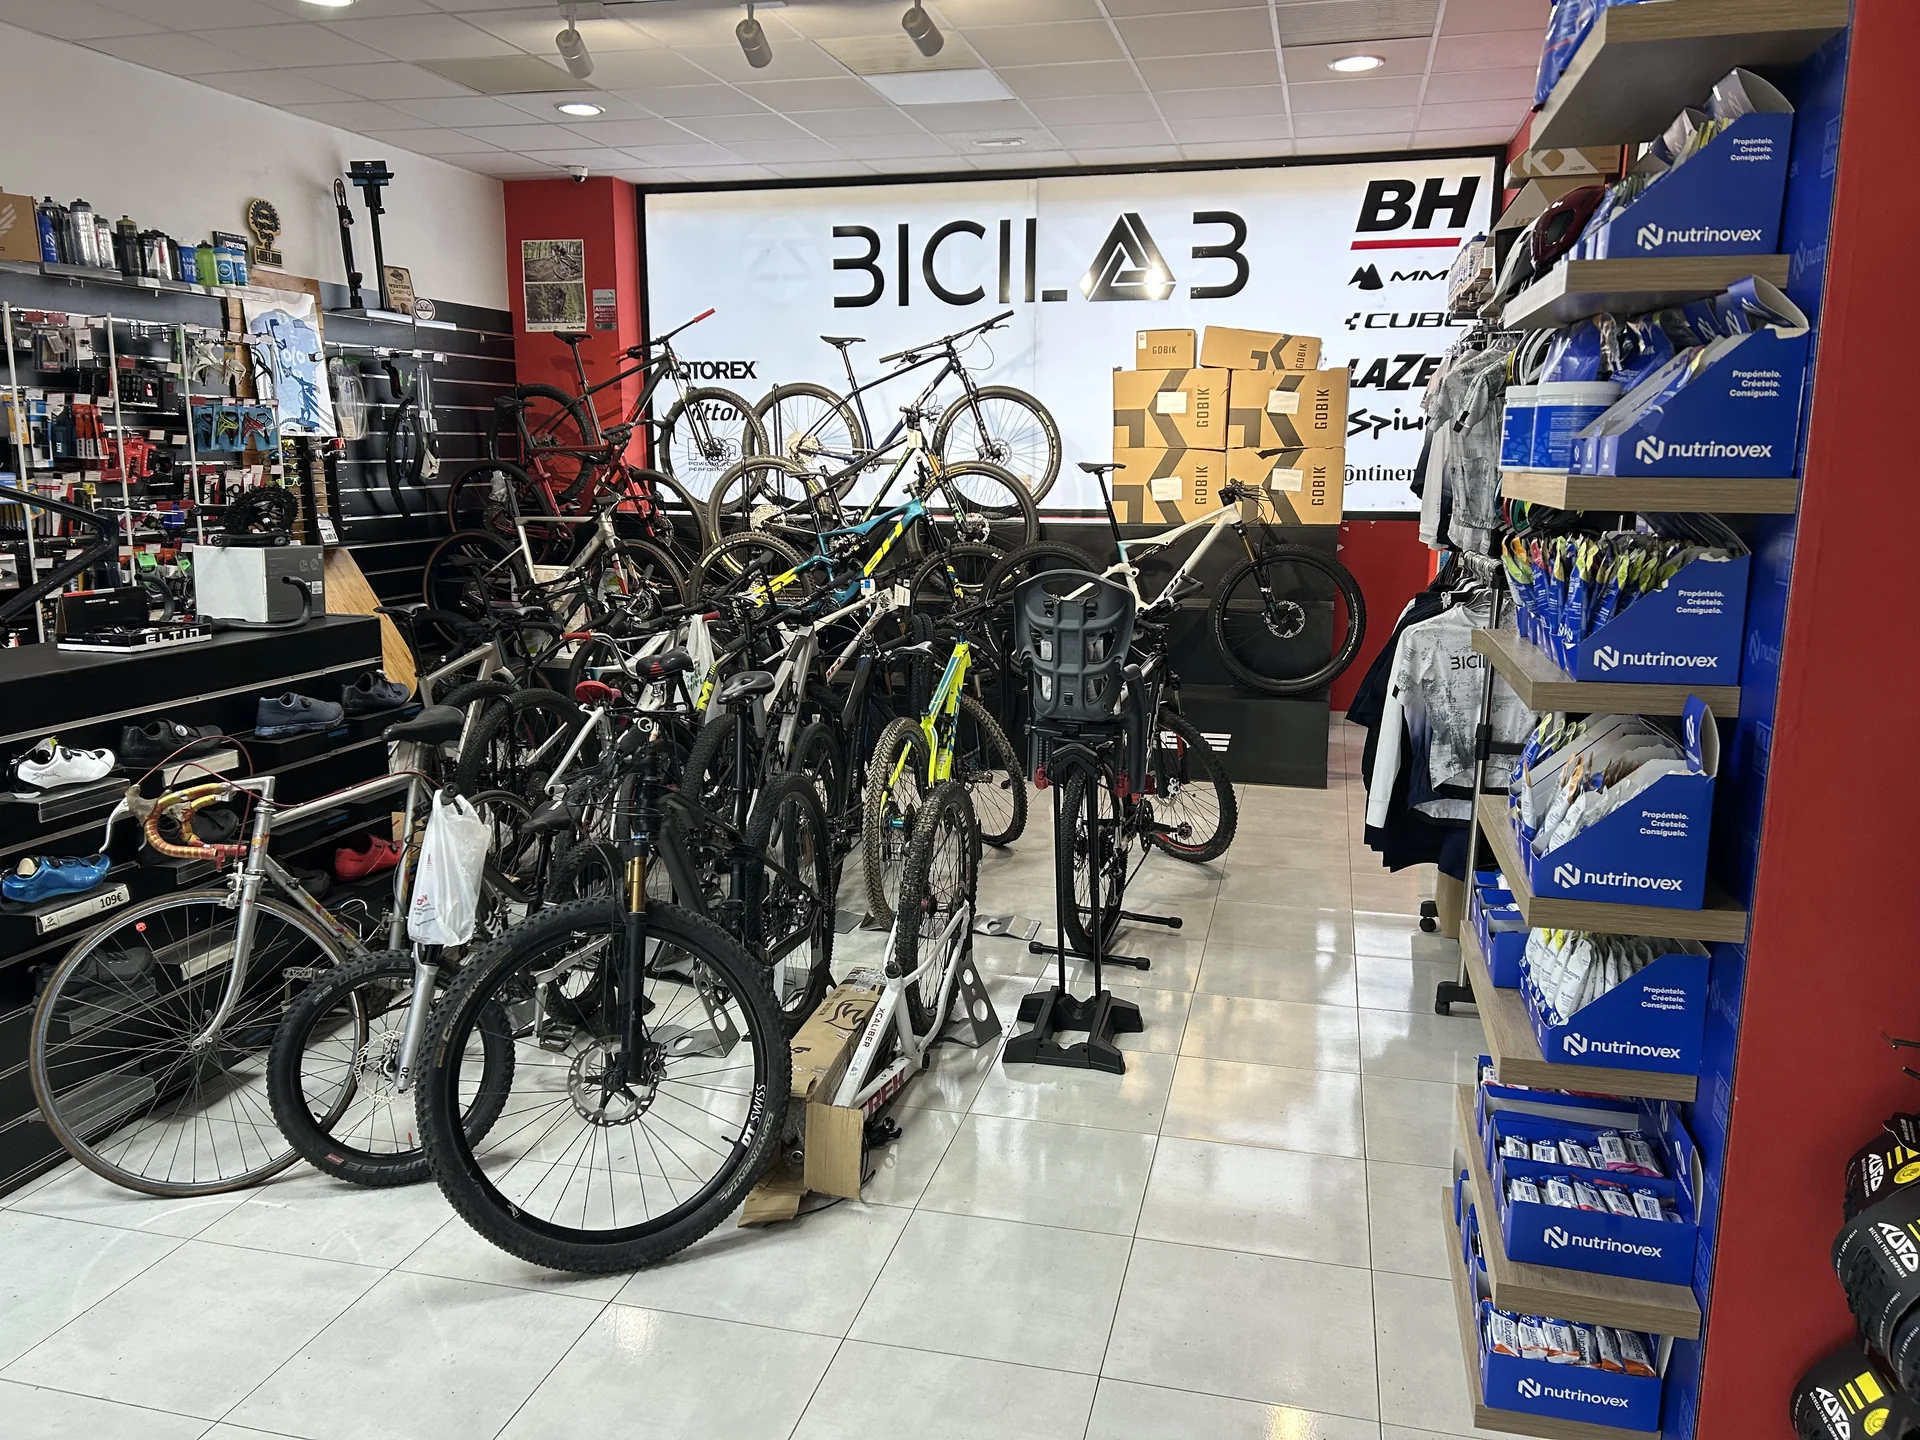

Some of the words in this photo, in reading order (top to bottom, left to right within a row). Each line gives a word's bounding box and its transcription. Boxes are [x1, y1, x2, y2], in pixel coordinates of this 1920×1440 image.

[1733, 137, 1774, 146] Propóntelo.
[1730, 153, 1772, 162] Consíguelo.
[1740, 146, 1773, 154] Créetelo.
[1355, 176, 1481, 232] BH
[1666, 227, 1761, 242] nutrinovex
[1390, 270, 1449, 281] MM
[1152, 345, 1177, 355] GOBIK
[1295, 343, 1308, 369] GOBIK
[660, 361, 758, 379] OTOREX
[1348, 353, 1443, 391] LAZE
[1732, 369, 1782, 380] Propóntelo.
[1741, 379, 1781, 388] Créetelo.
[1729, 388, 1780, 399] Consíguelo.
[1196, 387, 1210, 428] GOBIK
[1314, 388, 1330, 430] GOBIK
[1347, 408, 1431, 440] Spiu
[1667, 441, 1772, 457] nutrinovex
[1344, 464, 1416, 485] ontinen
[1194, 465, 1209, 505] GOBIK
[1311, 466, 1326, 506] GOBIK
[1678, 589, 1725, 598] Propóntelo.
[1686, 598, 1724, 606] Créetelo.
[1676, 605, 1723, 615] Consíguelo.
[1623, 652, 1717, 667] nutrinovex
[1641, 811, 1689, 820] Propóntelo.
[1650, 819, 1688, 828] Créetelo.
[1639, 827, 1688, 837] Consíguelo.
[1584, 873, 1682, 890] nutrinovex
[99, 892, 124, 909] 109€
[1643, 986, 1687, 996] Propóntelo.
[1651, 994, 1686, 1003] Créetelo.
[1641, 1001, 1685, 1011] Consíguelo.
[862, 1007, 886, 1048] XCALIBER
[1591, 1042, 1680, 1058] nutrinovex
[400, 1066, 410, 1080] 20
[741, 1124, 756, 1148] DT
[750, 1083, 767, 1123] SWISS
[1571, 1233, 1661, 1257] nutrinovex
[1868, 1226, 1883, 1245] BICYCLE
[1880, 1244, 1892, 1256] TYRE
[1888, 1255, 1908, 1278] COMPANY
[1544, 1385, 1628, 1407] nutrinovex
